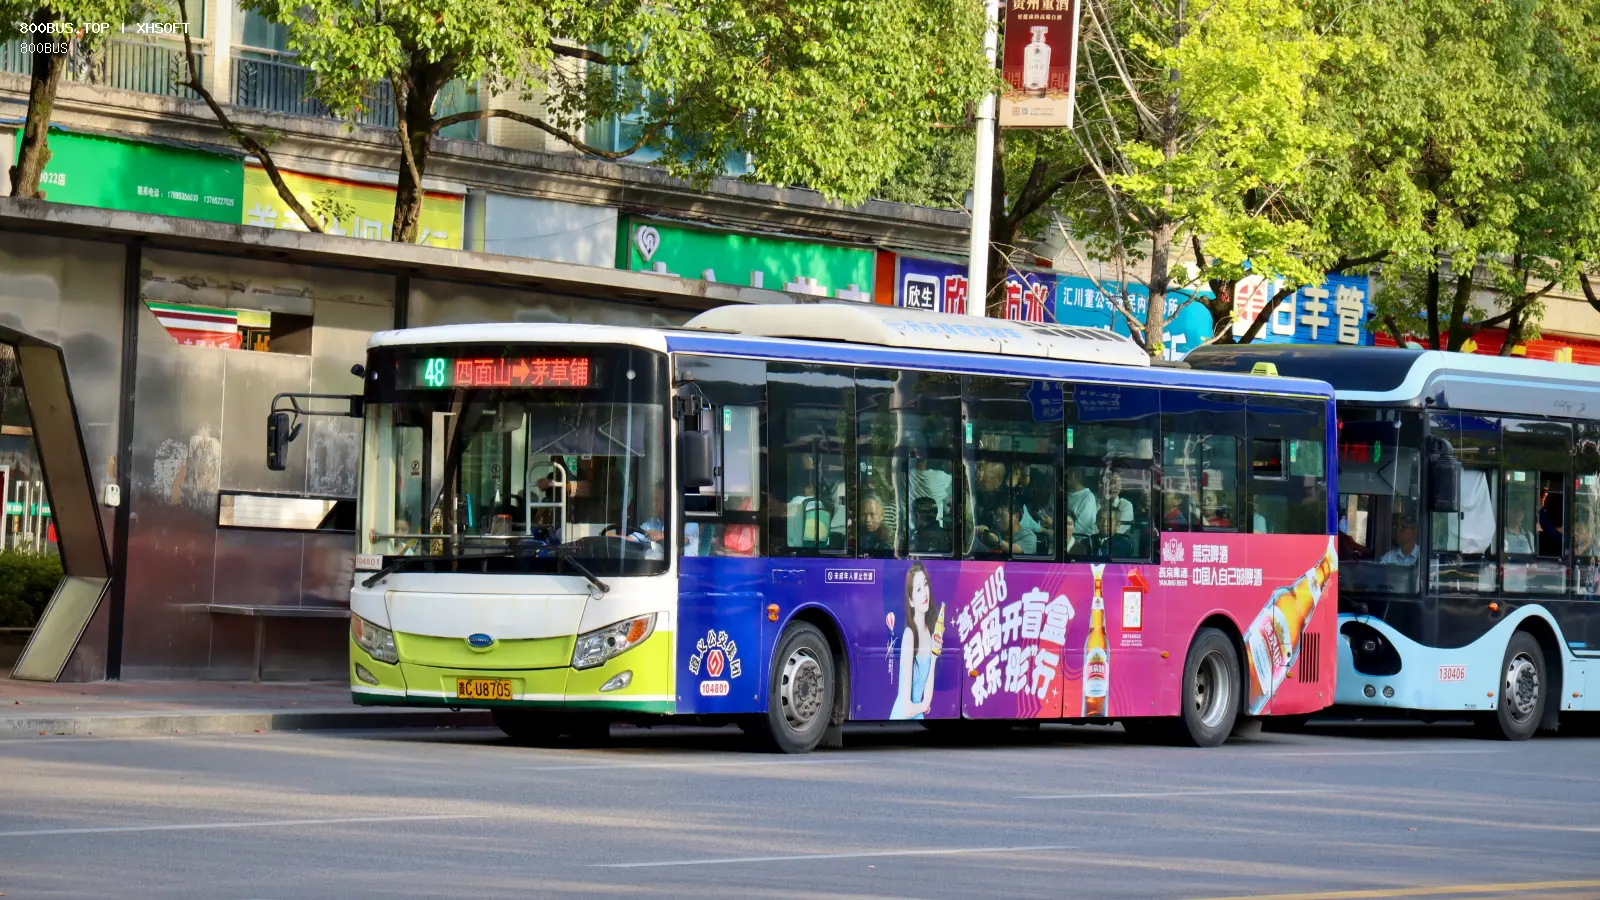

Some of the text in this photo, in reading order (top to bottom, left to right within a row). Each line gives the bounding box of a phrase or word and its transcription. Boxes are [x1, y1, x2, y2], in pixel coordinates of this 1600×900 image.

[908, 285, 933, 308] 欣生
[424, 358, 589, 387] 48 四面山 茅草铺
[1192, 544, 1229, 564] 燕京啤酒
[834, 571, 873, 581] 未成年人禁止饮酒
[1158, 567, 1188, 579] 燕京啤酒
[1192, 567, 1263, 587] 中国人自己的啤酒
[956, 565, 1008, 643] 燕京U8
[963, 586, 1076, 679] 扫码开盲盒
[1439, 667, 1465, 680] 130406
[702, 683, 728, 694] 104801
